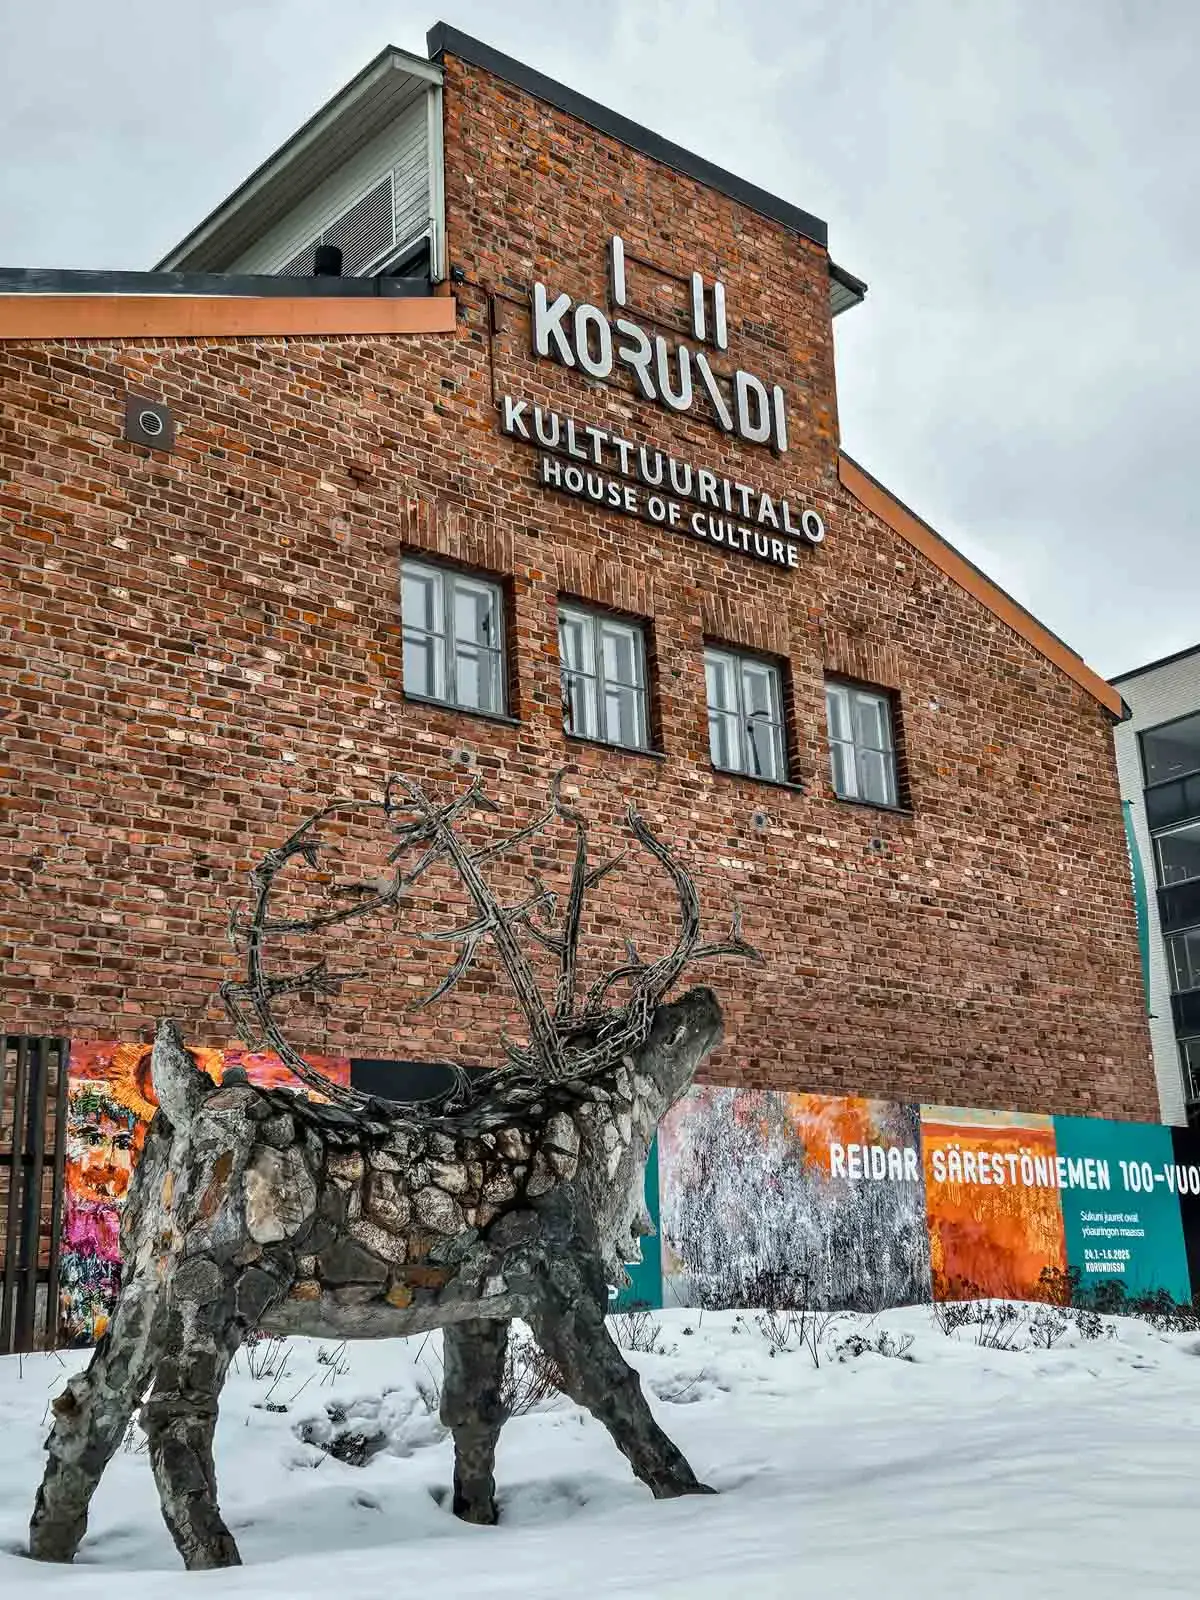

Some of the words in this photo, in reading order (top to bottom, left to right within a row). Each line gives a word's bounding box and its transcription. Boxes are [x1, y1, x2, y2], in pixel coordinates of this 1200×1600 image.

[532, 235, 788, 451] KORUNDI
[503, 394, 826, 544] KULTTUURITALO
[542, 457, 638, 513] HOUSE
[648, 496, 682, 526] OF
[691, 512, 799, 569] CULTURE
[829, 1143, 919, 1182] REIDAR
[931, 1143, 1111, 1191] SÄRESTÖNIEMEN
[1118, 1160, 1200, 1195] 100-VUO
[1081, 1225, 1119, 1238] yöauringon
[1119, 1228, 1145, 1237] maassa
[1103, 1211, 1124, 1224] juuret
[1124, 1212, 1139, 1223] ovat
[1085, 1262, 1126, 1273] KORUNDISSA
